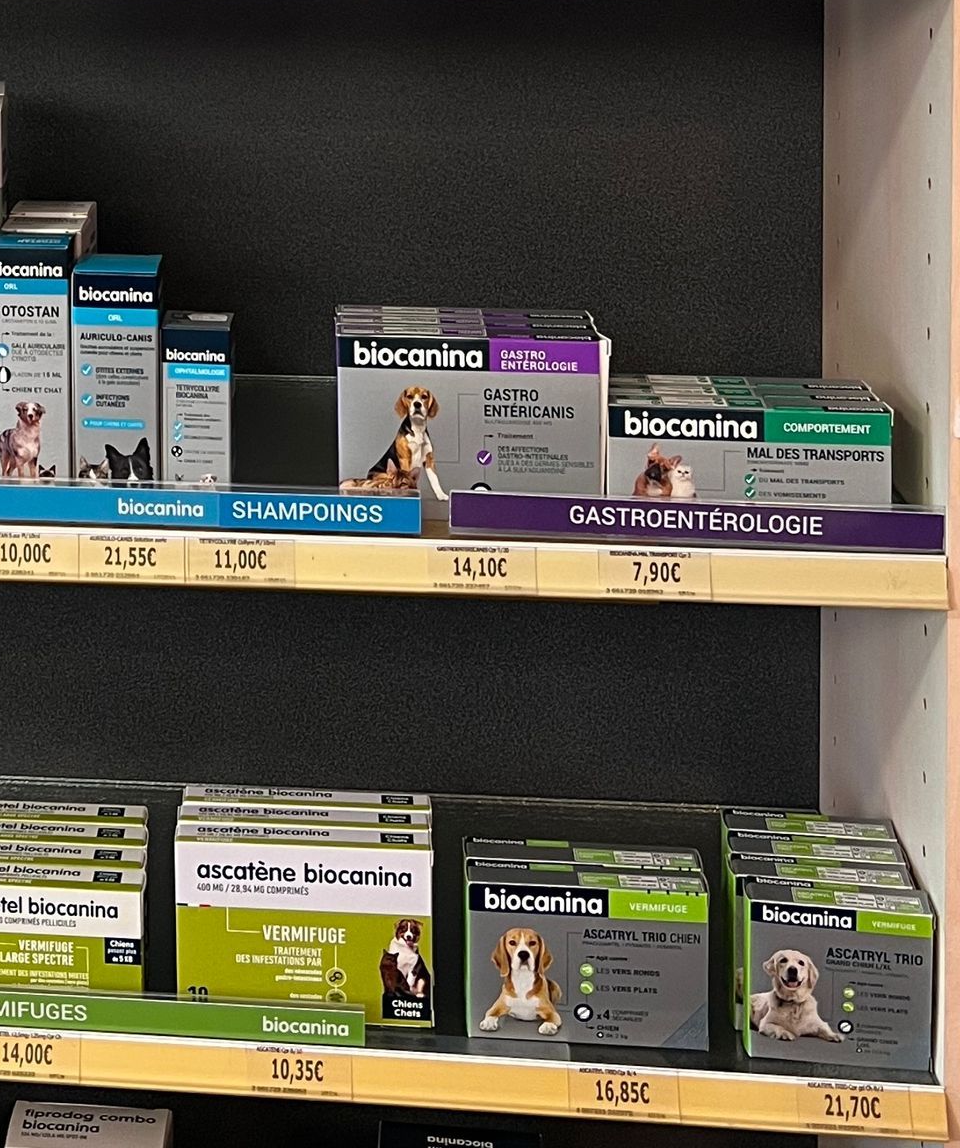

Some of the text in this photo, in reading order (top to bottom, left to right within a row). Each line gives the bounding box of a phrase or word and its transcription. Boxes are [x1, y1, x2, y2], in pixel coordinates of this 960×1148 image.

[79, 286, 153, 302] biocanina
[1, 306, 60, 318] OTOSTAN
[80, 333, 153, 342] AURICULO-CANIS
[166, 349, 225, 363] biocanina
[354, 340, 483, 368] biocanina
[500, 350, 546, 360] GASTRO
[501, 359, 578, 372] ENTÉROLOGIE
[484, 389, 539, 402] GASTRO
[484, 403, 575, 419] ENTÉRICANIS
[624, 410, 871, 439] biocanina COMPORTEMENT
[747, 447, 884, 462] MAL DES TRANSPORTS
[118, 497, 204, 518] biocanina
[232, 501, 383, 524] SHAMPOINGS
[569, 504, 823, 536] GASTROENTÉROLOGIE
[0, 542, 52, 566] 10,00€
[104, 545, 157, 569] 21,55€
[214, 549, 267, 573] 11,00€
[452, 556, 507, 579] 14,10€
[632, 561, 681, 586] 7,90€
[197, 860, 412, 887] ascatène biocanina
[484, 887, 688, 914] biocanina VERMIFUGE
[762, 905, 916, 931] biocanina VERMIFUGE
[262, 925, 346, 944] VERMIFUGE
[583, 929, 701, 945] ASCATRYL TRIO CHIEN
[236, 954, 322, 966] DES INFESTATIONS PAR
[273, 946, 322, 956] TRAITEMENT
[826, 948, 923, 966] ASCATRYL TRIO
[392, 999, 423, 1009] Chiens
[394, 1009, 421, 1018] Chats
[262, 1015, 349, 1037] biocanina
[1, 1042, 53, 1067] 14,00€
[271, 1058, 324, 1085] 10,35€
[595, 1080, 650, 1107] 16,85€
[825, 1094, 881, 1122] 21,70€
[22, 1119, 100, 1134] biocanina
[99, 1113, 156, 1125] combo
